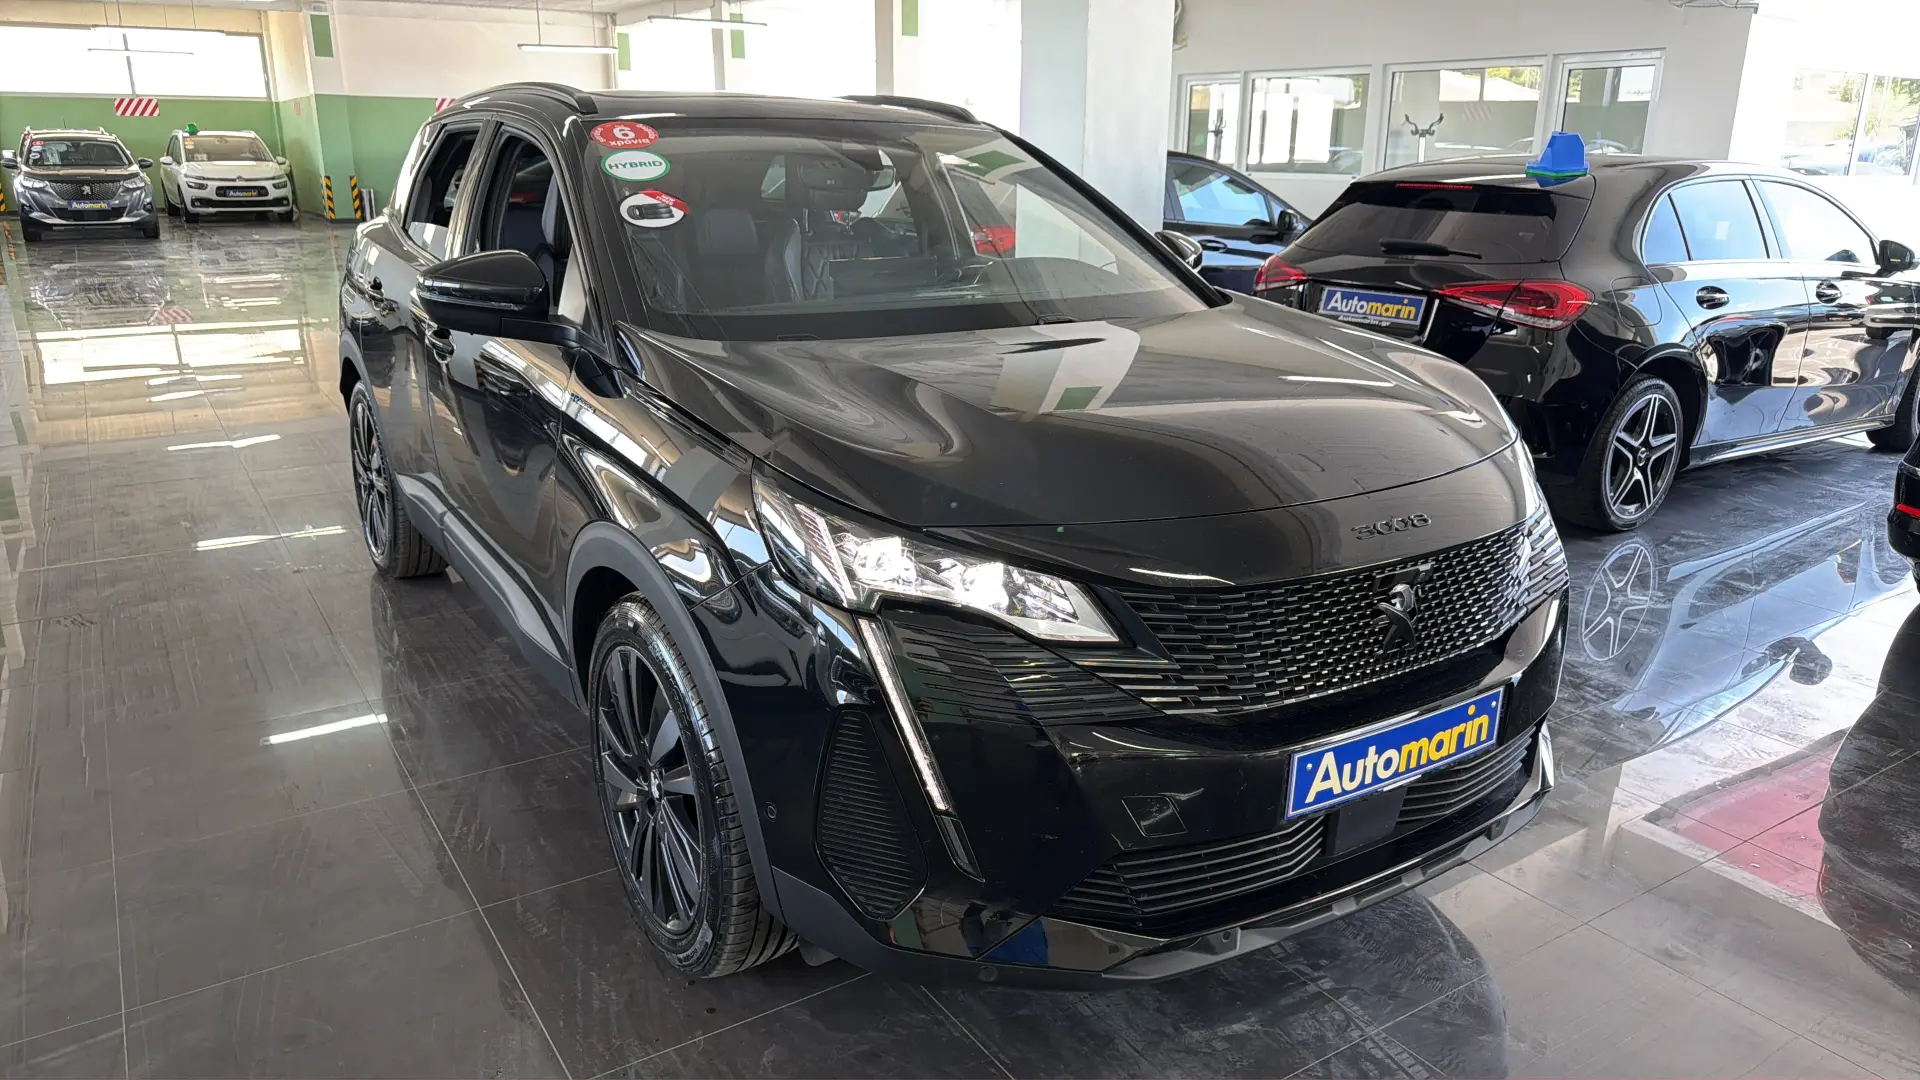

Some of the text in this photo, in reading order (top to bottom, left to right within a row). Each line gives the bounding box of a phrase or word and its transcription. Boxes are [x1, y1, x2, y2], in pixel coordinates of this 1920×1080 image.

[613, 126, 636, 140] 6
[608, 160, 663, 171] HYBRID
[72, 201, 108, 209] Automarin
[1326, 291, 1417, 320] Automarin
[1337, 315, 1392, 327] Automarin.gr
[1350, 512, 1432, 541] 3008
[1304, 704, 1490, 805] Automarin
